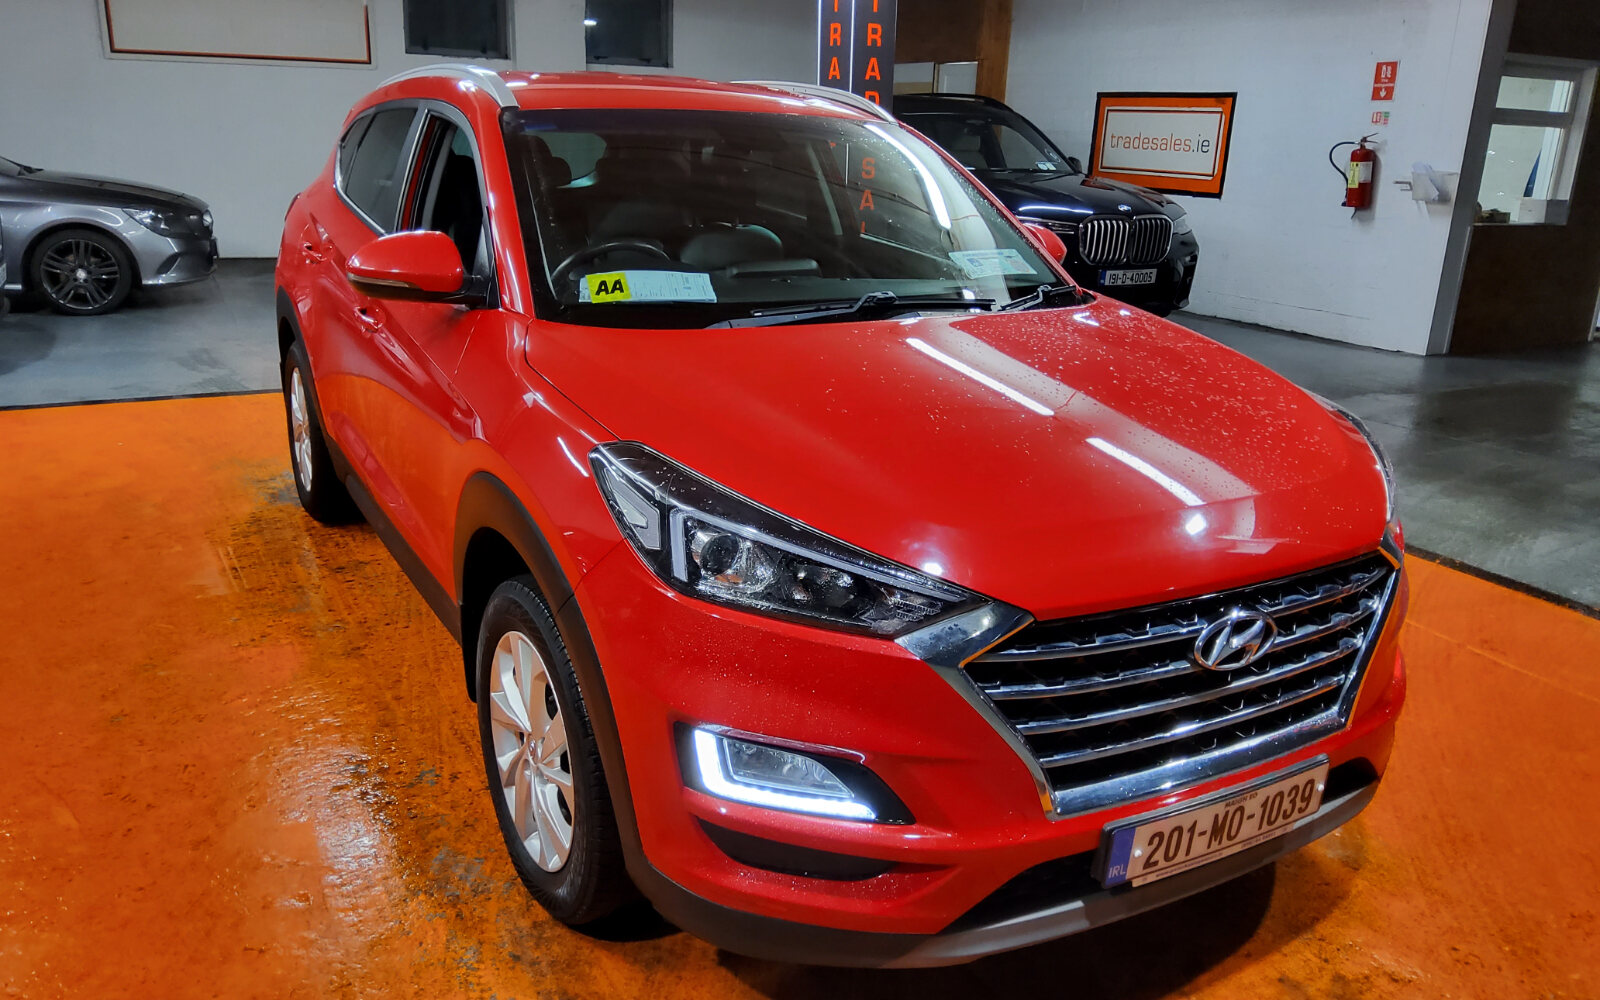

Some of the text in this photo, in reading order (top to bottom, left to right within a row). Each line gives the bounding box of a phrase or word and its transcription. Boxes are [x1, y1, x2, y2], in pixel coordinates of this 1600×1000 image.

[1110, 132, 1210, 154] tradesales.ie
[1108, 271, 1154, 285] 191-D-40005
[595, 279, 624, 296] AA
[1142, 778, 1316, 871] 201-MO-1039
[1108, 865, 1127, 879] IRL
